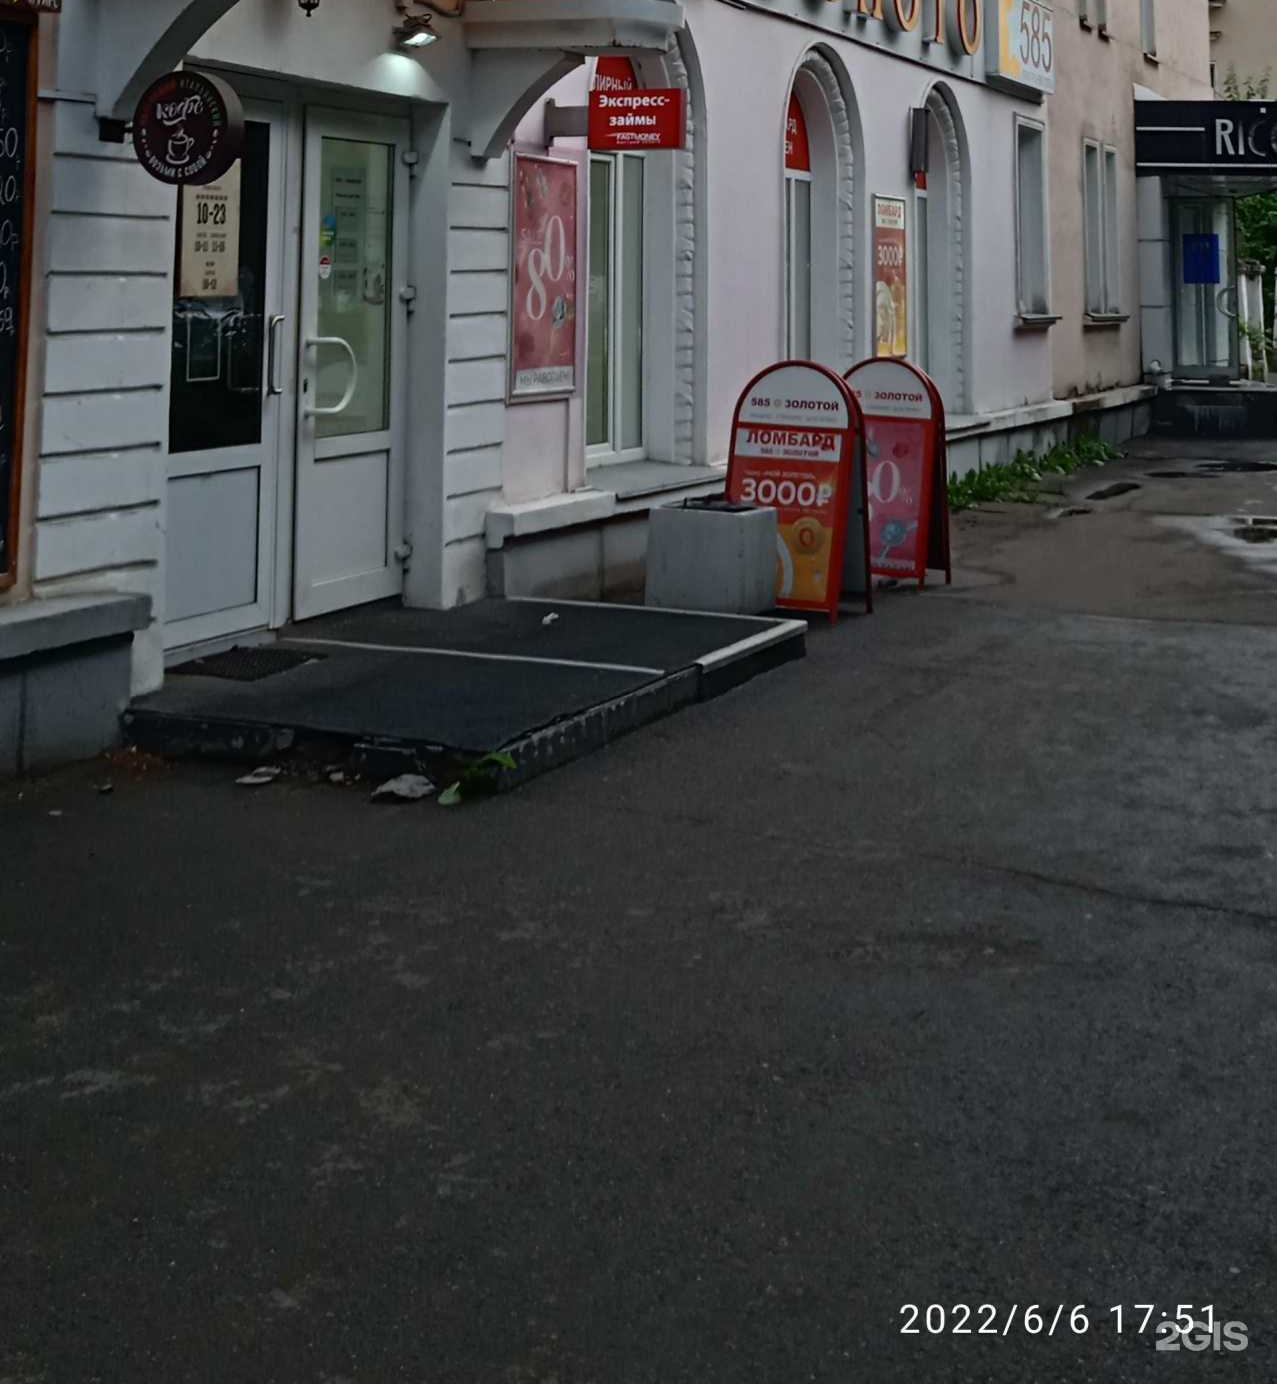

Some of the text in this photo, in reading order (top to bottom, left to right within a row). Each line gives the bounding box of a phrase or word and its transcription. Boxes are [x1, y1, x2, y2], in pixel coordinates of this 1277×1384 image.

[1020, 0, 1051, 72] 585
[599, 94, 670, 110] Экспресс-
[609, 112, 657, 127] займы
[196, 202, 227, 225] 10-23
[751, 397, 771, 408] 585
[746, 429, 836, 452] ЛОМБАРД
